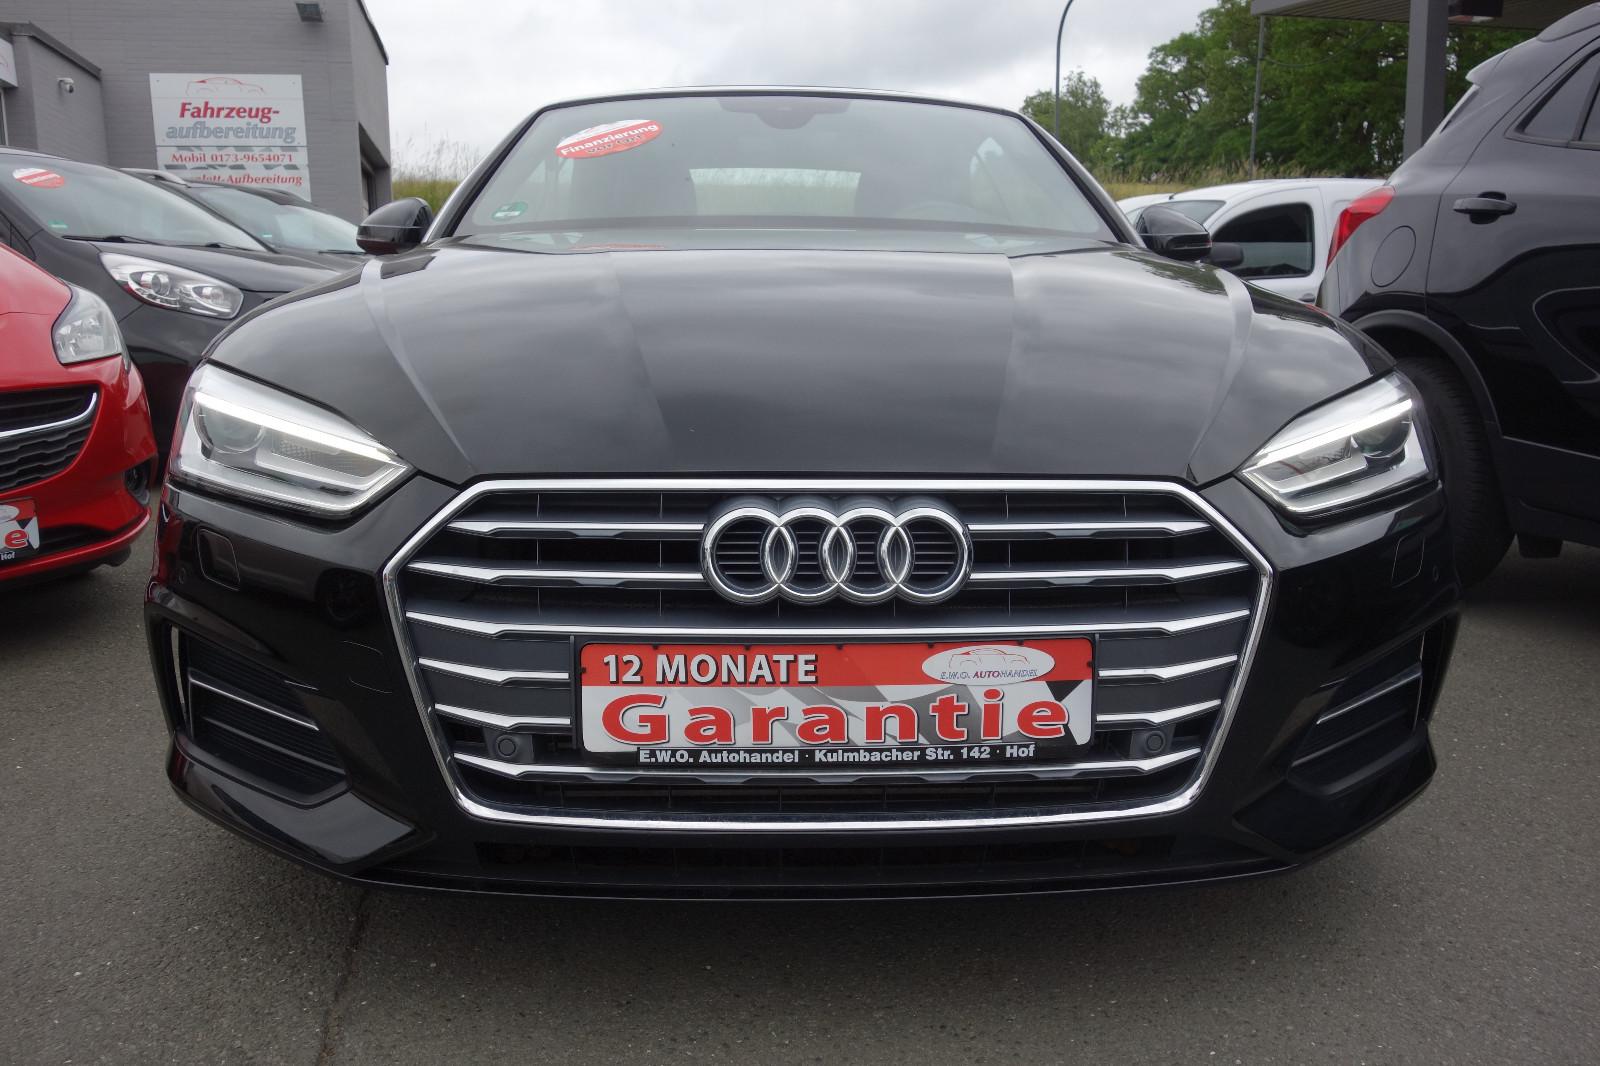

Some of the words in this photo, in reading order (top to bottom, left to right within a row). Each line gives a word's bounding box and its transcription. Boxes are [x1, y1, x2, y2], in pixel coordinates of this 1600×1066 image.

[179, 101, 280, 124] Fahrzeug-
[166, 121, 297, 144] aufbereitung
[560, 124, 660, 156] Finanzierung
[171, 153, 206, 163] Mobil
[211, 153, 293, 163] 0173-9654071
[603, 654, 643, 683] 12
[656, 654, 817, 684] MONATE
[940, 671, 971, 680] E.W.O.
[973, 669, 1038, 679] AUTOHANDEL
[601, 688, 1069, 746] Garantie
[639, 750, 694, 763] E.W.O.
[699, 749, 799, 763] Autohandel
[814, 748, 921, 763] Kulmbacher
[925, 747, 954, 760] Str.
[960, 746, 991, 759] 142
[1005, 744, 1036, 757] Hof
